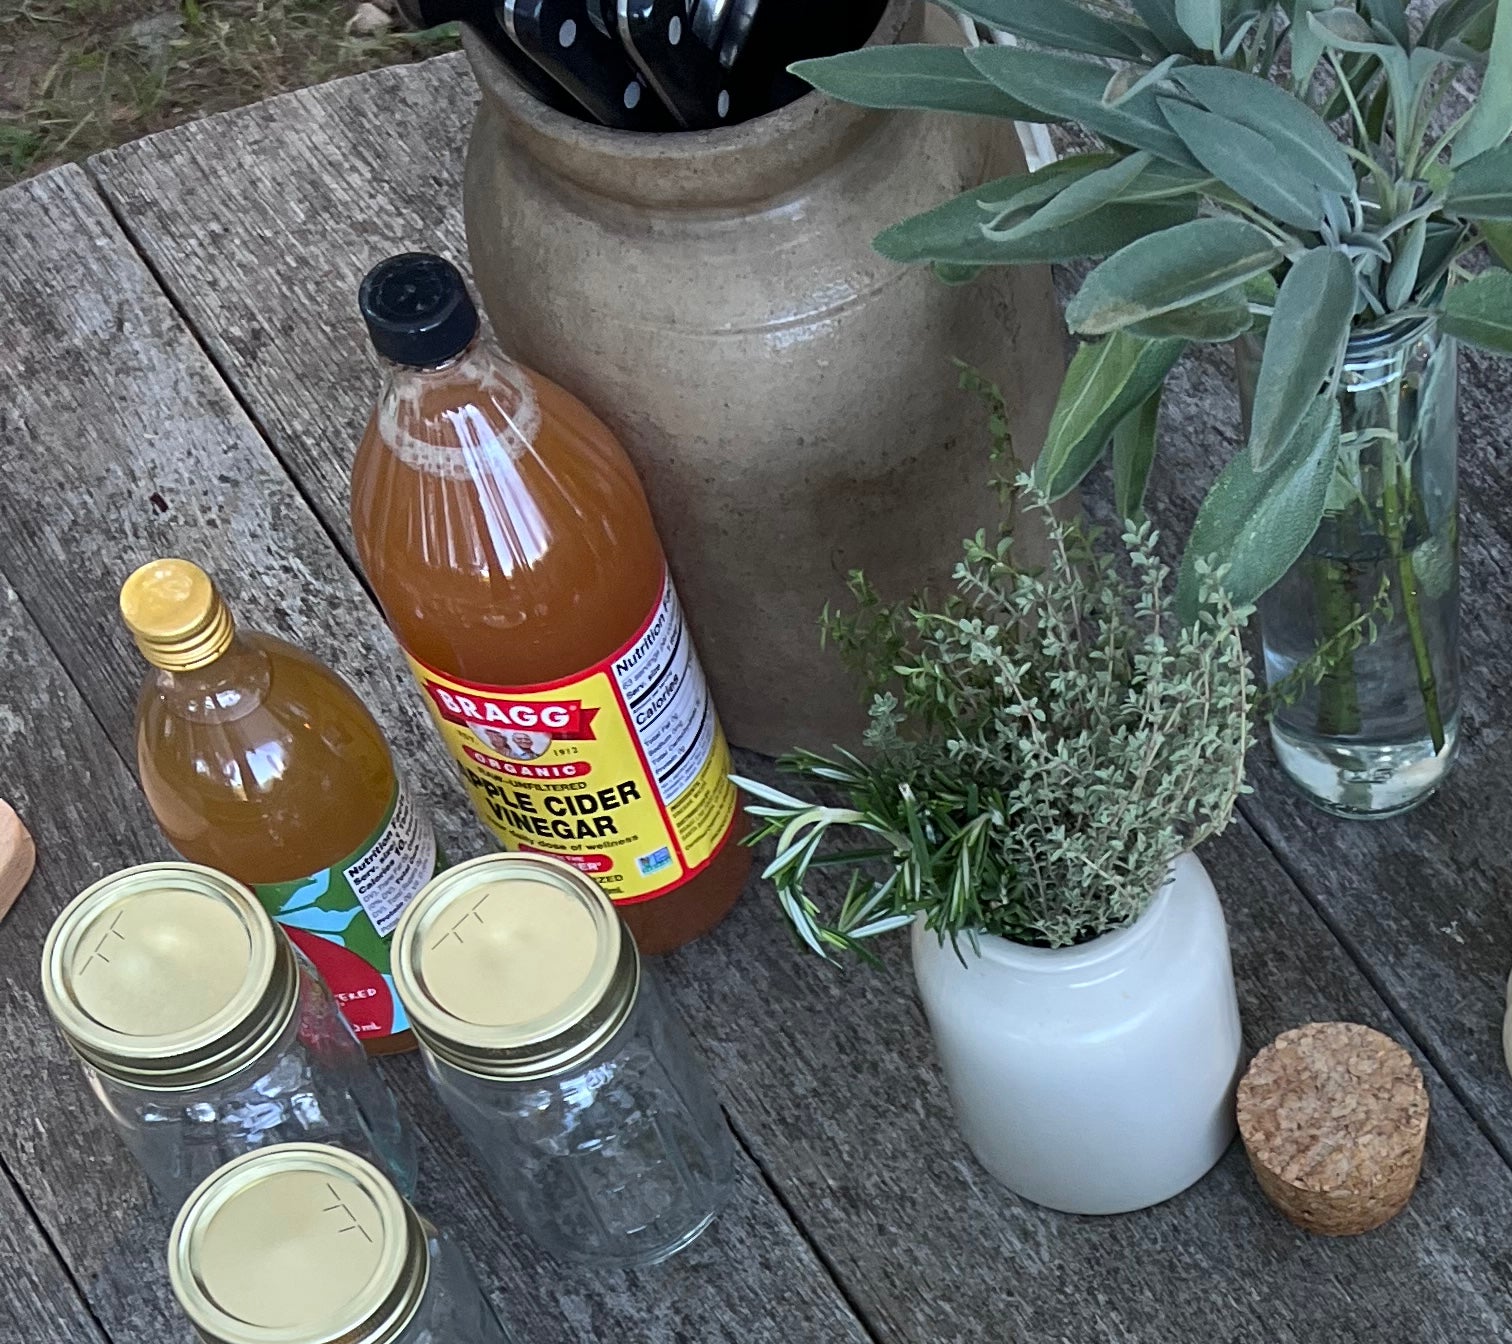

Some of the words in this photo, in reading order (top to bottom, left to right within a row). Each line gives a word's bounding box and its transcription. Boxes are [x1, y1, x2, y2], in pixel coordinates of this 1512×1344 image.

[616, 613, 666, 677] Nutrition
[436, 688, 571, 728] BRAGG
[635, 673, 679, 725] Calories
[474, 752, 577, 778] ORGANIC
[457, 759, 538, 814] APPLE
[543, 780, 642, 817] CIDER
[486, 797, 619, 840] VINEGAR
[348, 830, 394, 878] Nutrition
[586, 835, 639, 850] wellness
[358, 859, 396, 895] Calories
